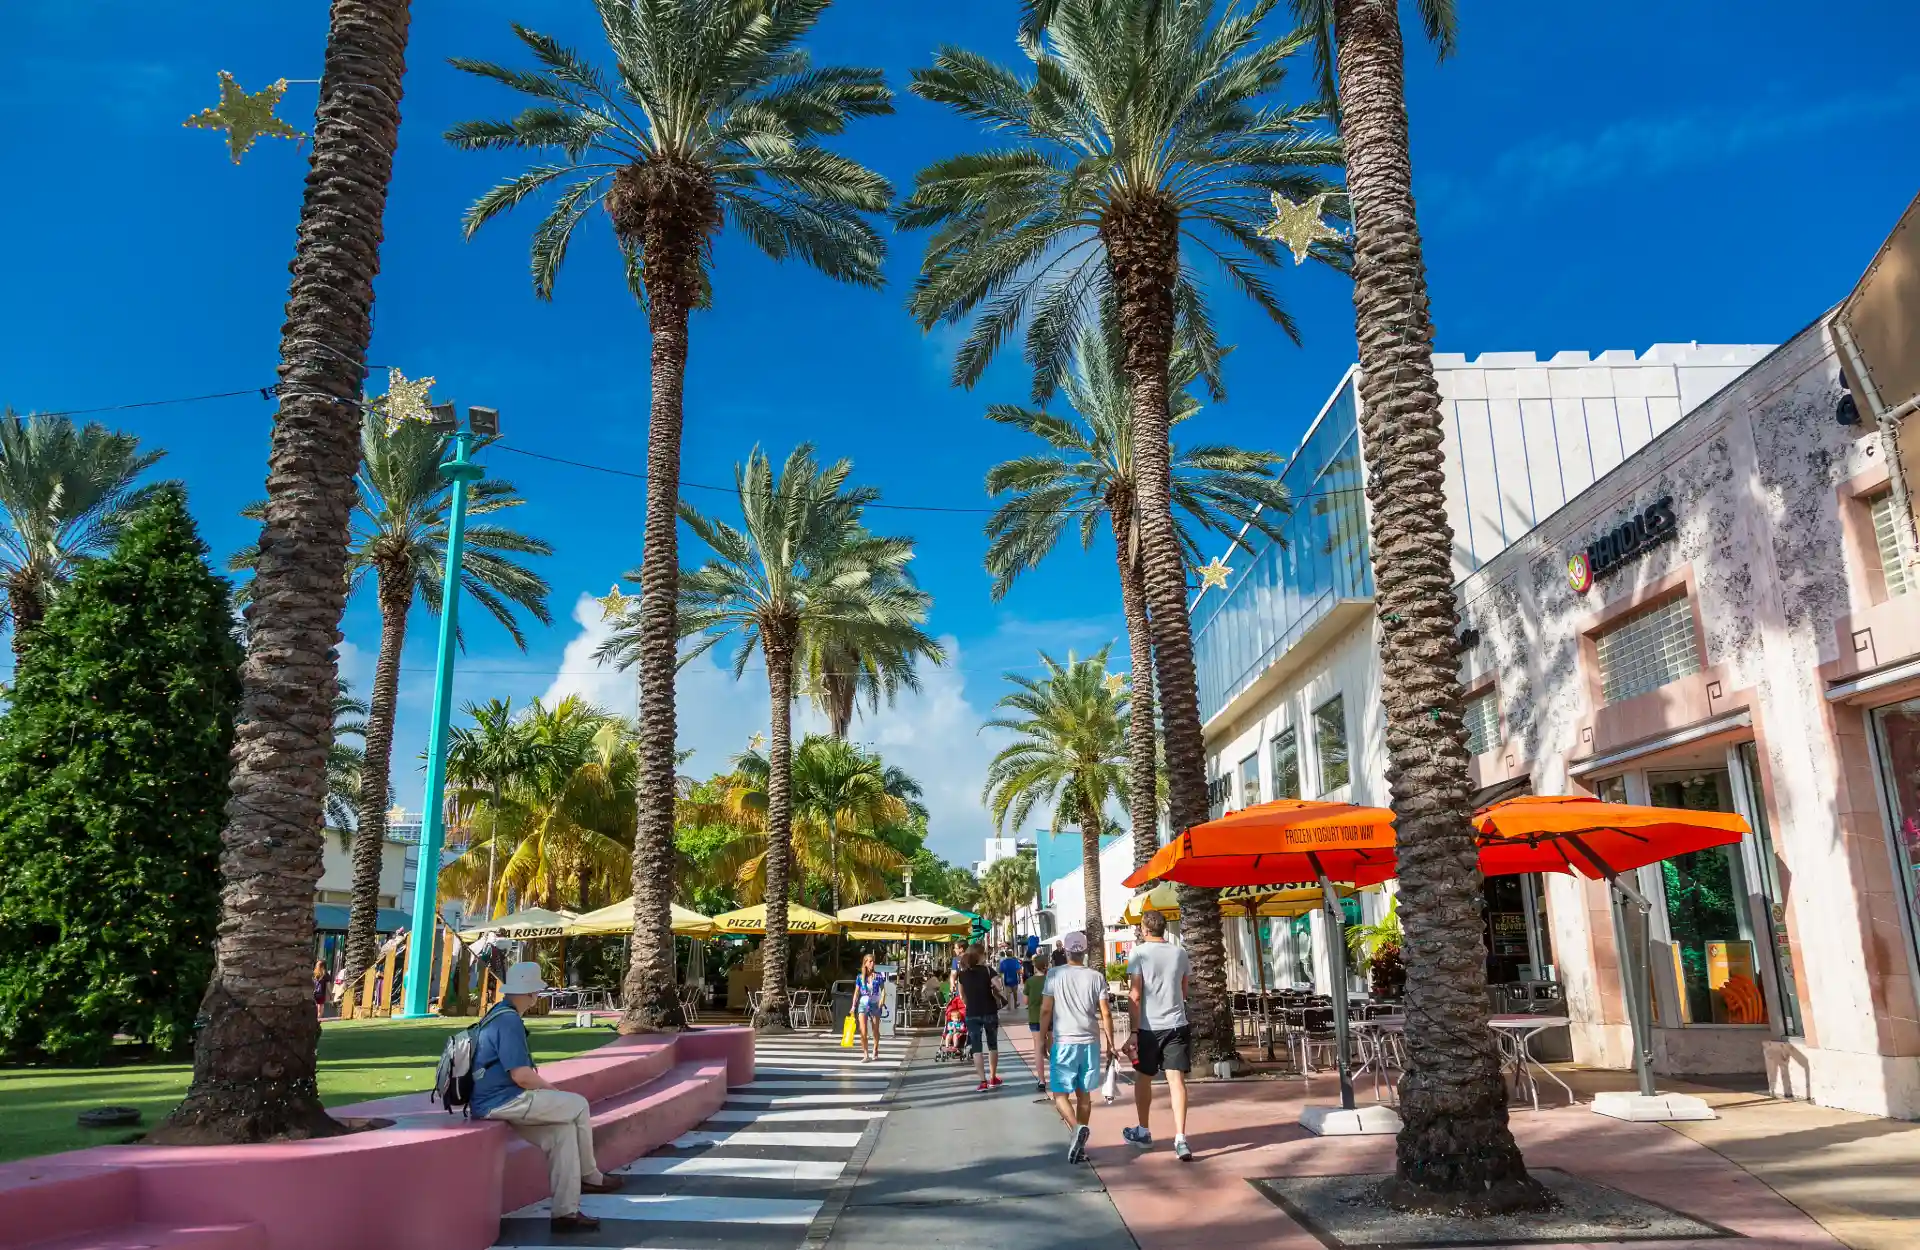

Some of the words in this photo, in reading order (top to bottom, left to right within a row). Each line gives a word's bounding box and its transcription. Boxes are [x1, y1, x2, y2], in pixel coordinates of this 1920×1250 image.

[1569, 556, 1584, 585] 16
[1284, 828, 1312, 844] FROZEN
[1313, 826, 1340, 842] YOGURT
[1341, 825, 1359, 841] YOUR
[1360, 825, 1375, 840] WAY
[727, 918, 761, 928] PIZZA
[861, 913, 895, 922] PIZZA
[898, 914, 949, 925] RUSTICA
[514, 927, 564, 938] RUSTICA
